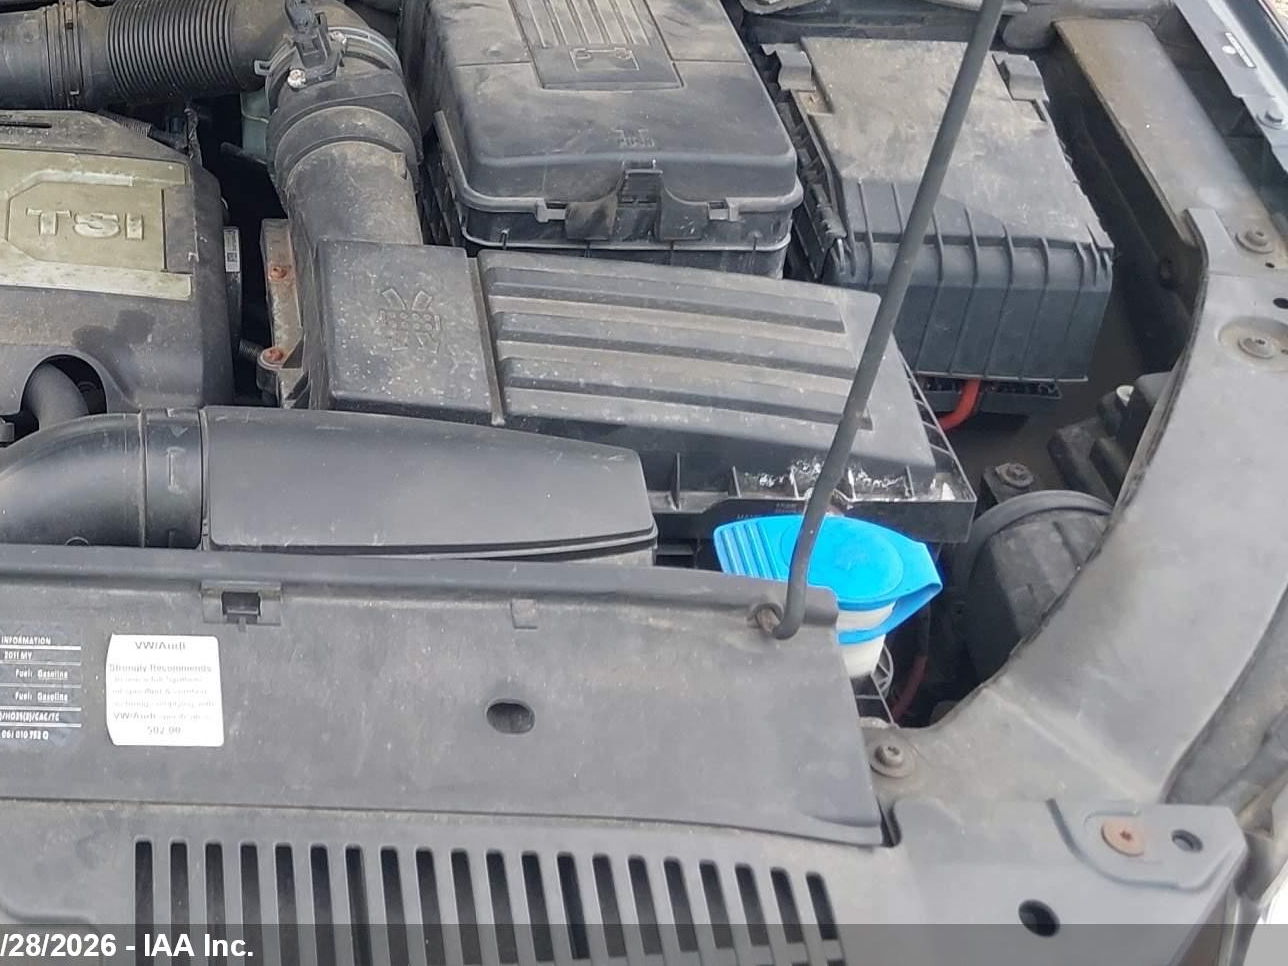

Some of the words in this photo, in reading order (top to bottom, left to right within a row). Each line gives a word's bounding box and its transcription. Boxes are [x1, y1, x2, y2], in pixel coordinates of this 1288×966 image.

[26, 208, 144, 241] TSI
[1, 636, 51, 645] INFORMATION
[135, 641, 186, 650] VW/Audi
[15, 669, 33, 678] Fuel:
[37, 669, 69, 679] Gasoline
[15, 691, 33, 701] Fuel:
[37, 691, 69, 701] Gasoline
